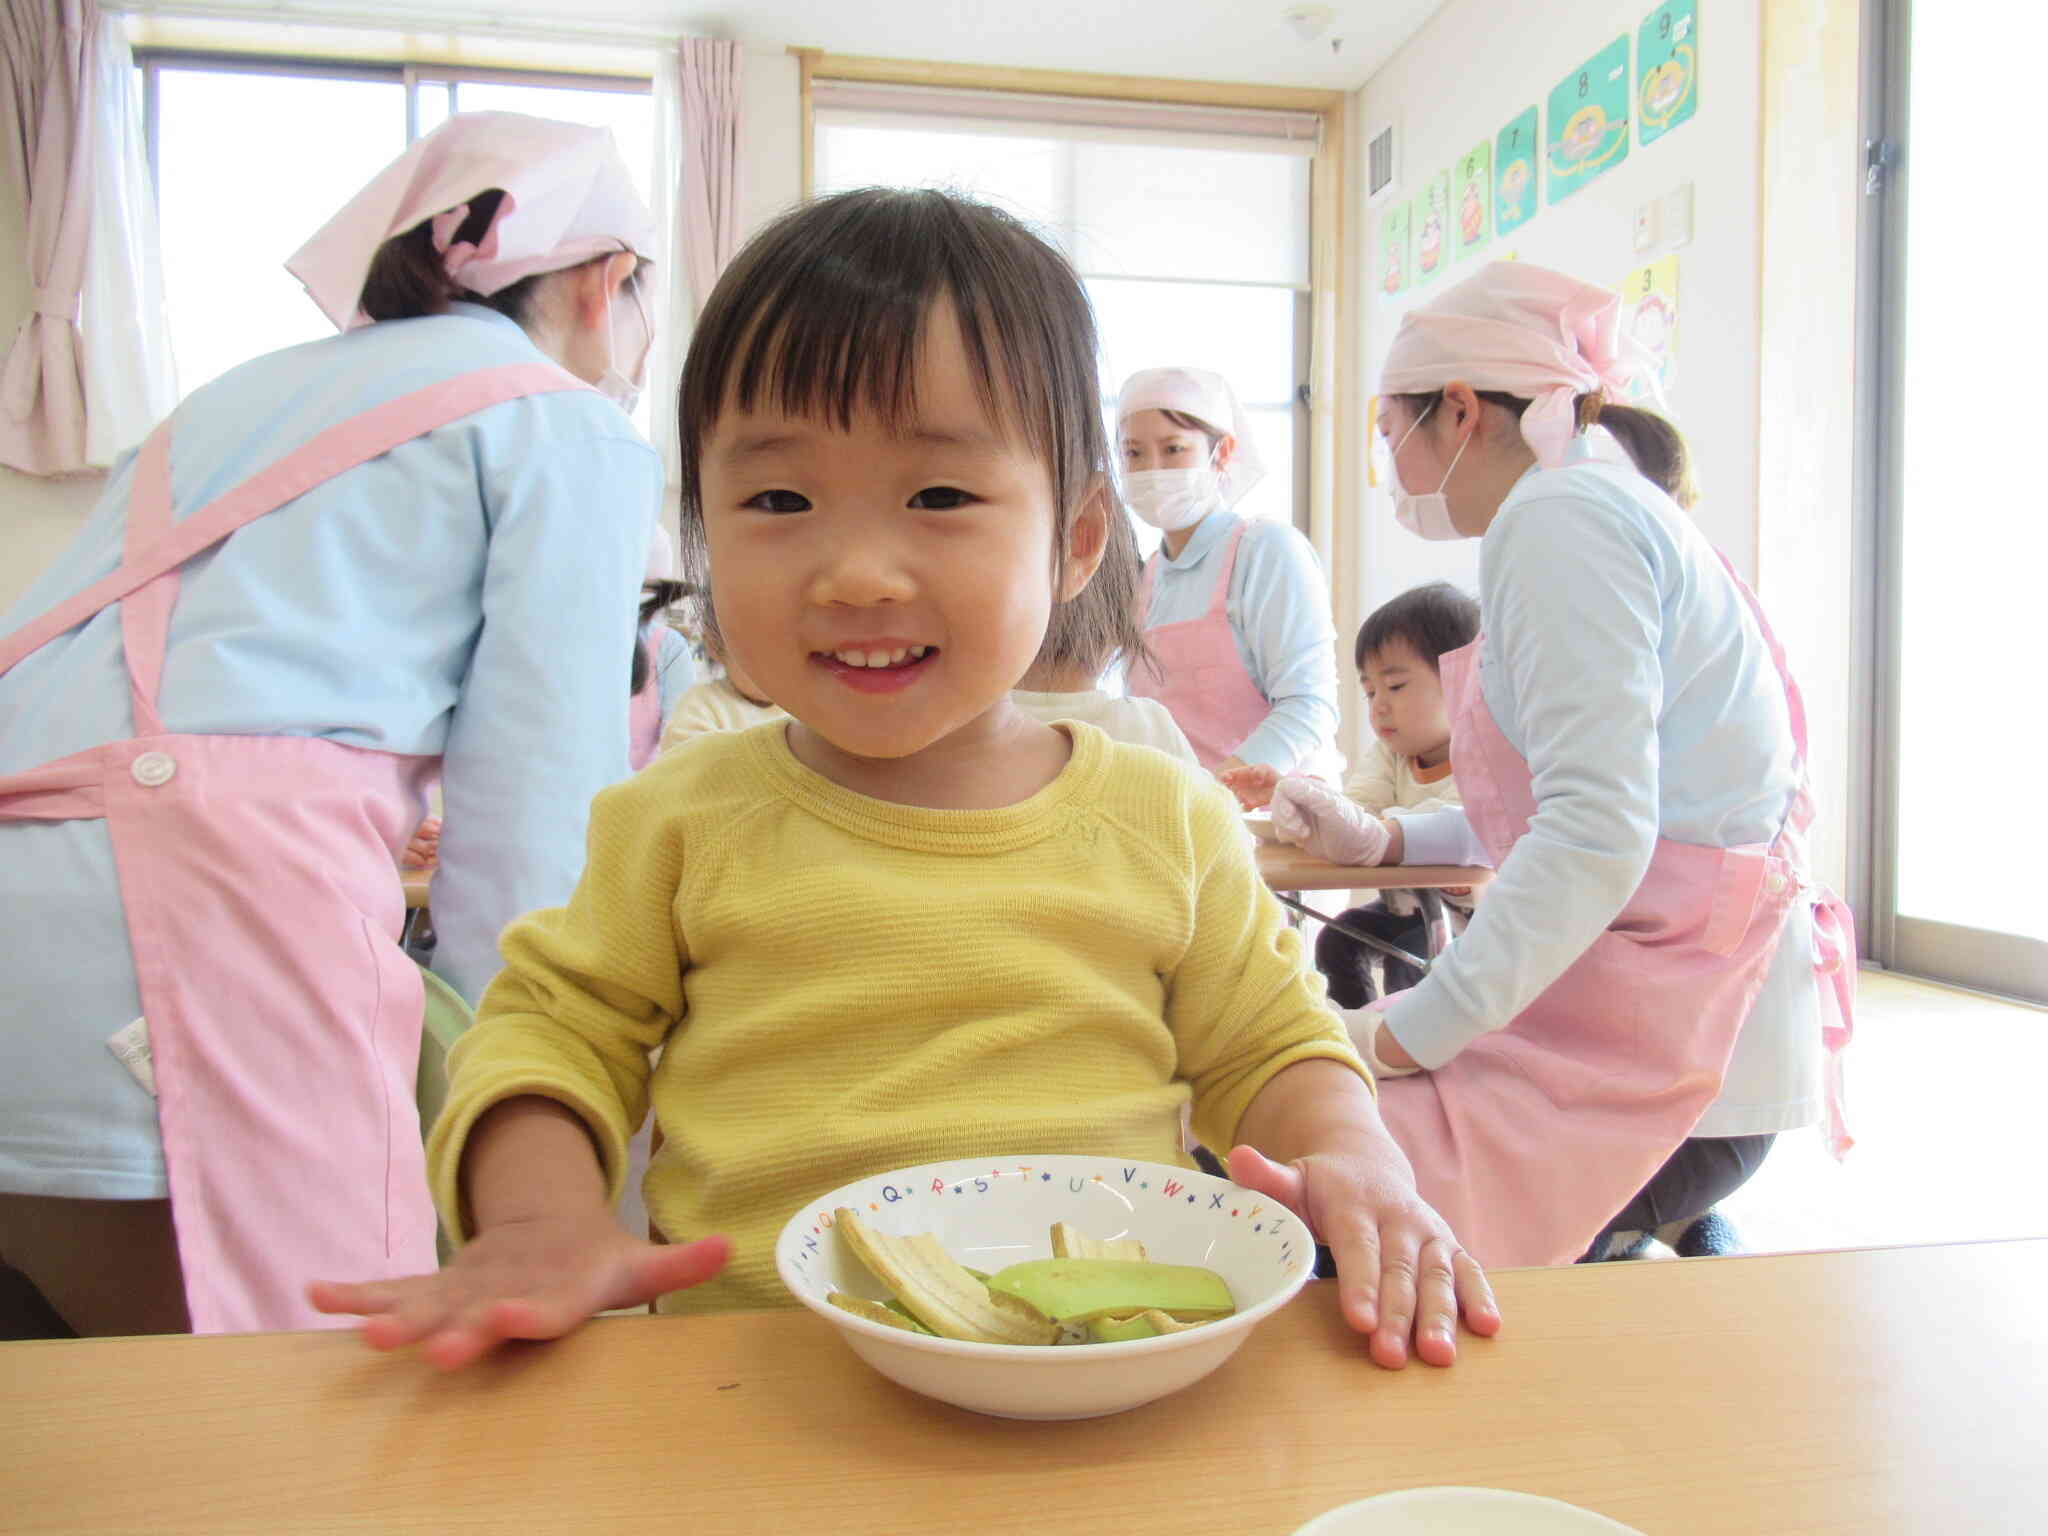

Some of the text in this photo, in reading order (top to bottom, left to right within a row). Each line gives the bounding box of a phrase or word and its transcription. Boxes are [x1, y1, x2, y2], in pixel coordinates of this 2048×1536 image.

[1659, 12, 1671, 40] 9
[1578, 71, 1589, 98] 8
[1466, 156, 1475, 179] 6
[1640, 268, 1653, 292] 3
[803, 1235, 819, 1255] N
[818, 1212, 833, 1228] O
[882, 1185, 903, 1202] Q
[931, 1178, 944, 1195] R
[974, 1178, 989, 1193] S
[1018, 1166, 1033, 1182] T
[1069, 1176, 1085, 1193] U
[1123, 1167, 1137, 1183] V
[1163, 1179, 1184, 1197] W
[1208, 1193, 1224, 1209] X
[1269, 1219, 1285, 1235] Z
